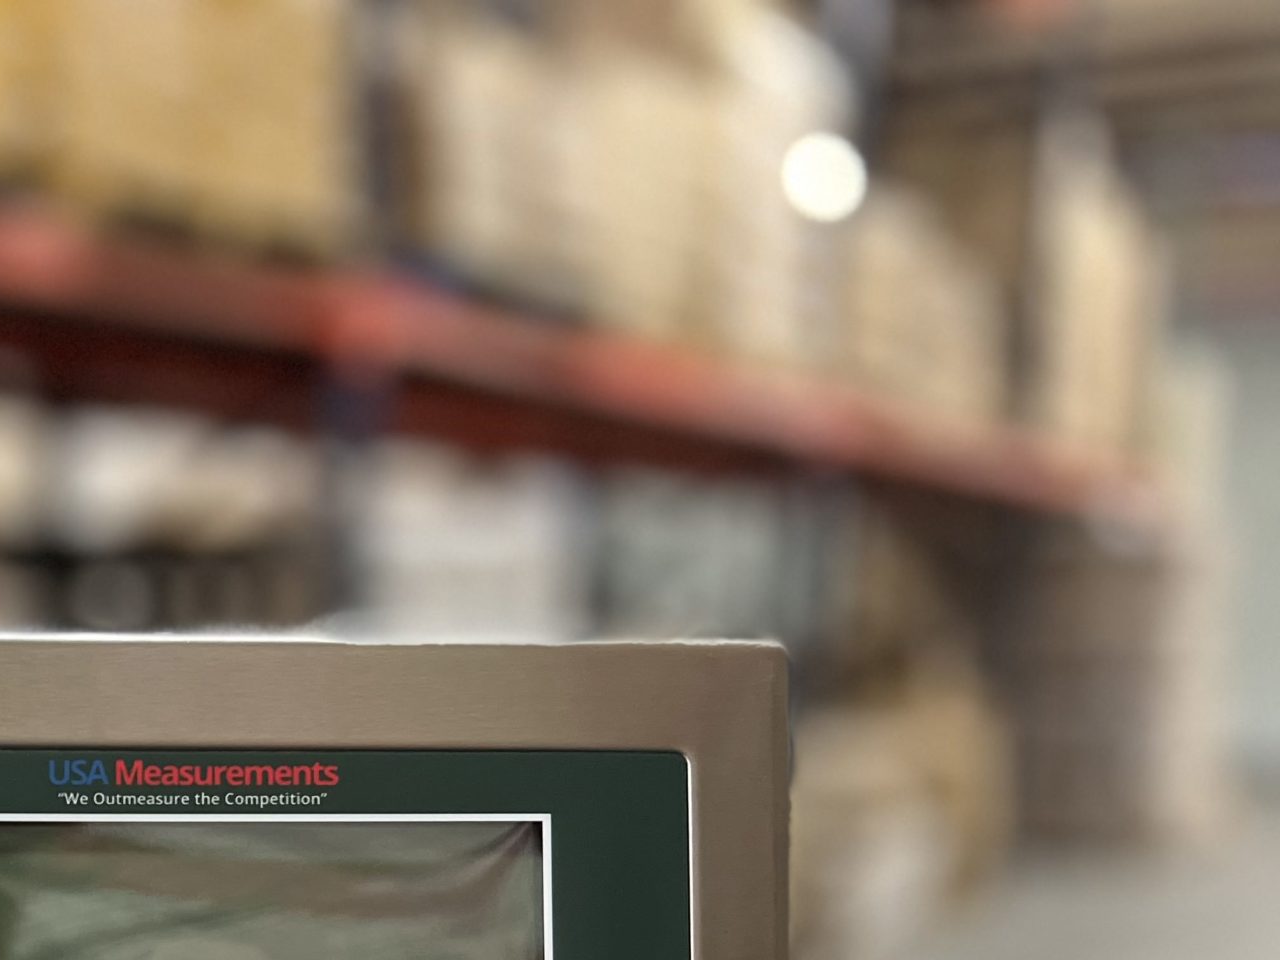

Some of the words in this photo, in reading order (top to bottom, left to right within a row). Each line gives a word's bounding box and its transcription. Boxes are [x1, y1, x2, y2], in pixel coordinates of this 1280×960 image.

[48, 759, 108, 786] USA
[115, 759, 339, 787] Measurements
[93, 792, 190, 806] Outmeasure
[194, 792, 220, 805] the
